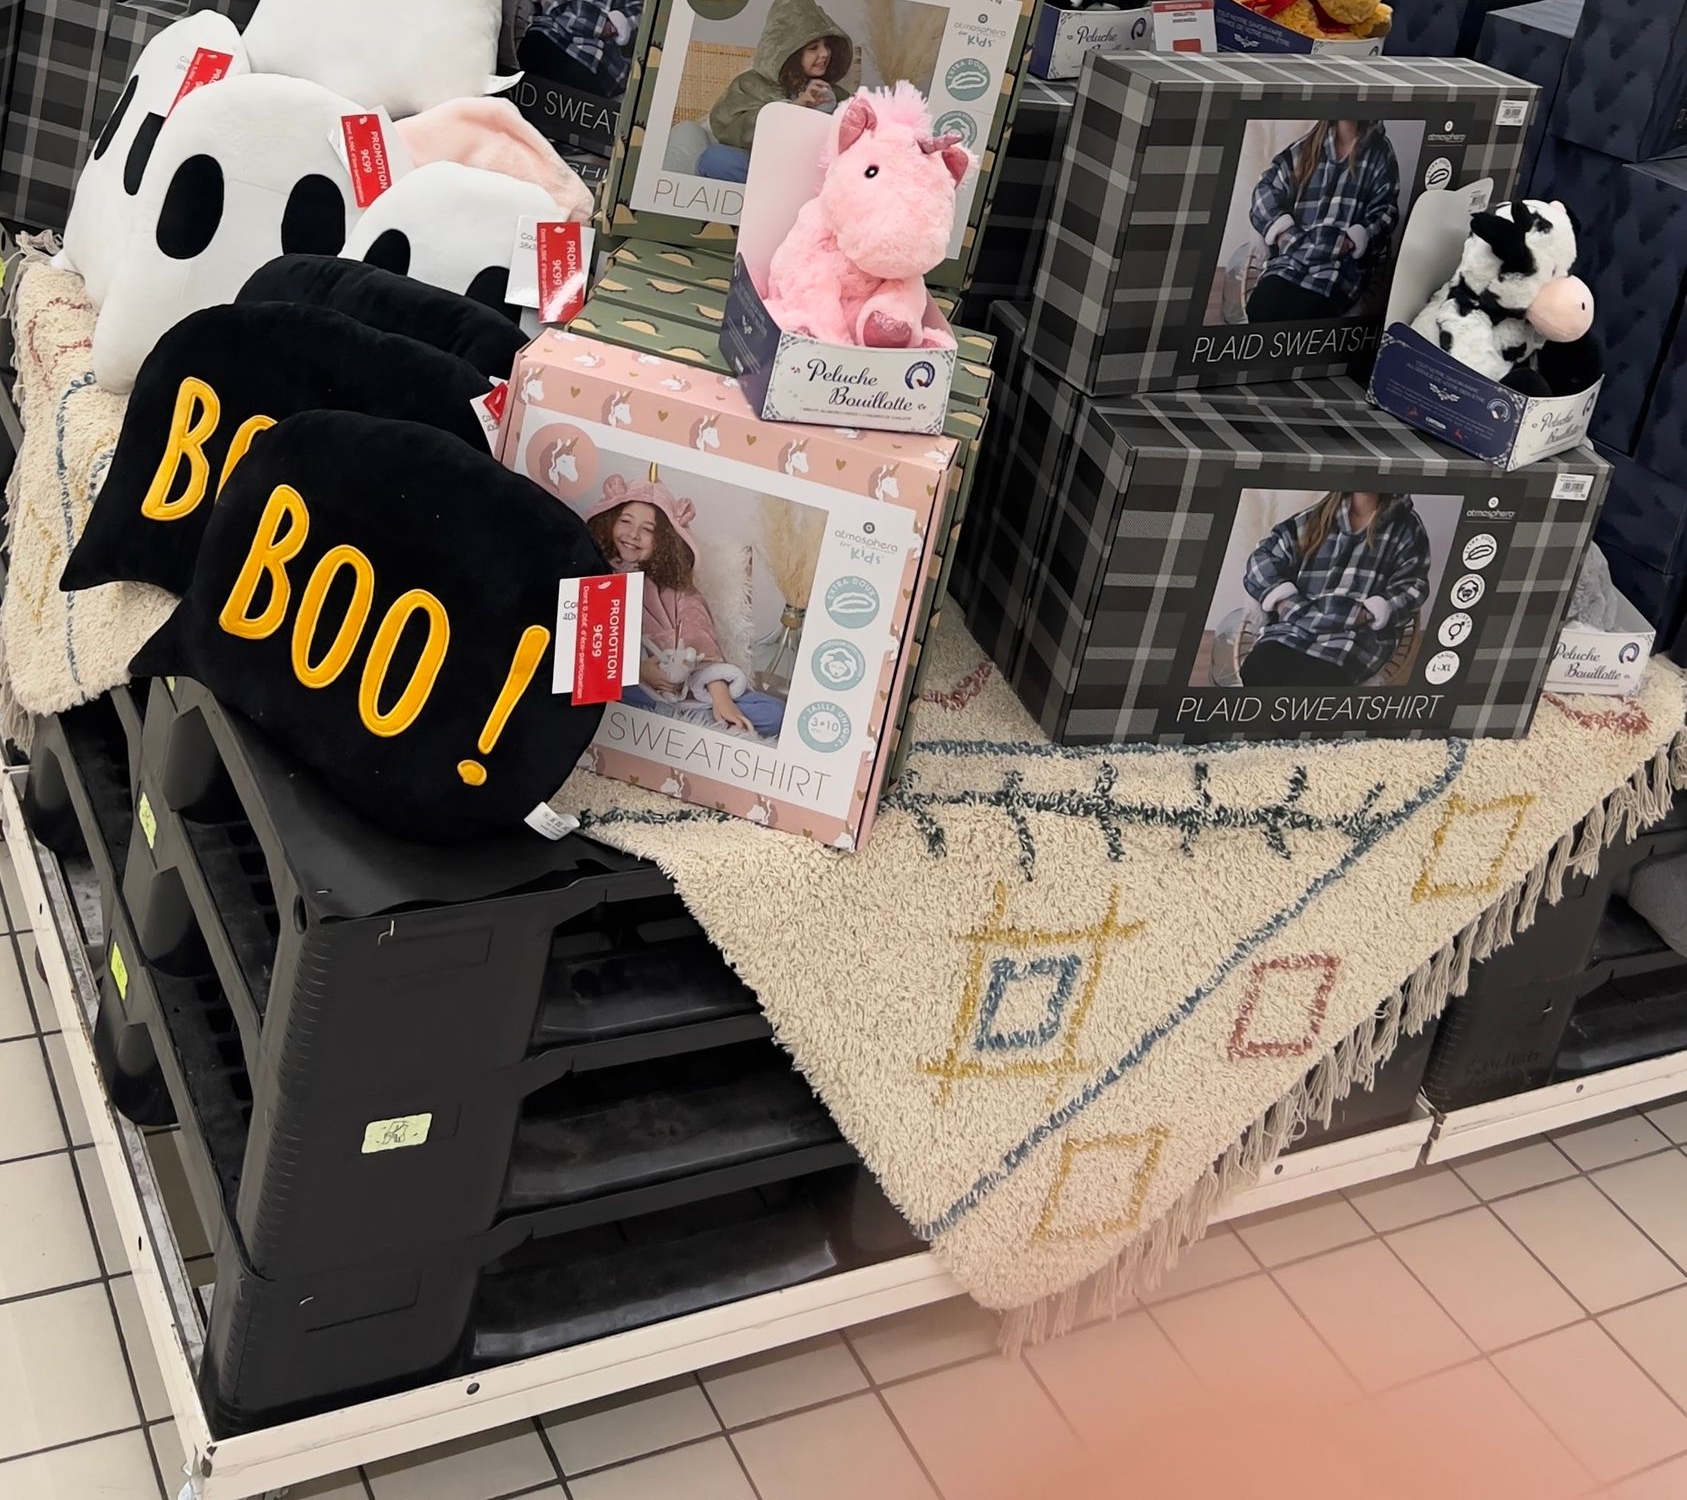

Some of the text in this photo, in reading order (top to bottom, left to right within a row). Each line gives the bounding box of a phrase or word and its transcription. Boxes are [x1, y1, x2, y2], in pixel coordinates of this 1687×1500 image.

[1077, 26, 1117, 44] Peluche
[544, 91, 622, 134] SWEAT
[370, 131, 388, 190] PROMOTION
[653, 179, 744, 216] PLAID
[1191, 325, 1384, 364] PLAID SWEATSH
[807, 359, 878, 387] Peluche
[829, 387, 912, 411] Bouillotte
[1466, 510, 1515, 520] atmosphera
[835, 529, 898, 552] atmosphera
[827, 579, 849, 599] EXTRA
[852, 578, 875, 598] DOUX
[218, 484, 551, 787] BOO !
[592, 624, 603, 657] 9€99
[607, 599, 620, 679] PROMOTION
[1553, 642, 1600, 661] Peluche
[1432, 664, 1451, 672] L-XL
[1565, 662, 1621, 680] Bouillotte
[806, 702, 835, 717] TAILLE
[1176, 695, 1444, 722] PLAID SWEATSHIRT
[838, 708, 850, 747] UNIQUE
[608, 712, 831, 801] SWEATSHIRT
